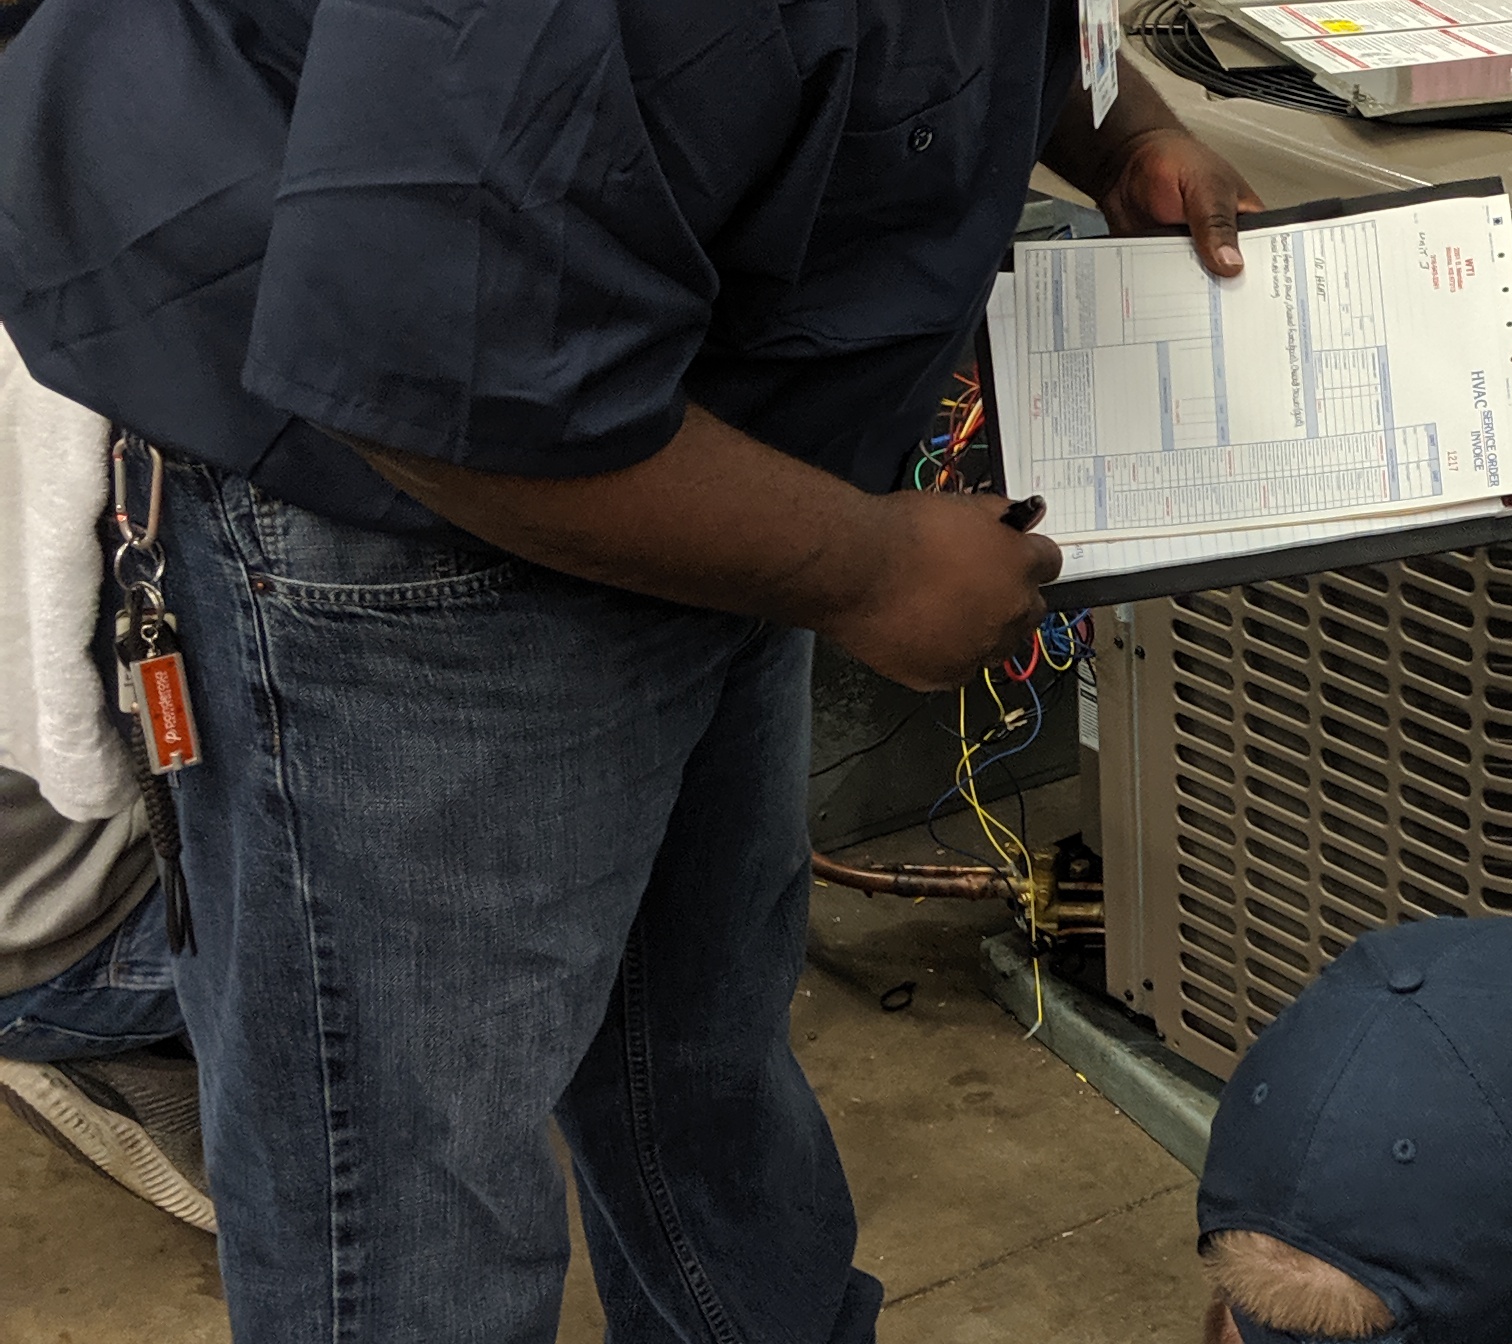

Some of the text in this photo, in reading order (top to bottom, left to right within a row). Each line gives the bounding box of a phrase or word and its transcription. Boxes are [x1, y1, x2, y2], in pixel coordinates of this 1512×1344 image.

[1469, 370, 1499, 488] HVAC SERVICE ORDER
[1469, 429, 1484, 471] INVOICE
[1446, 450, 1459, 472] 1217
